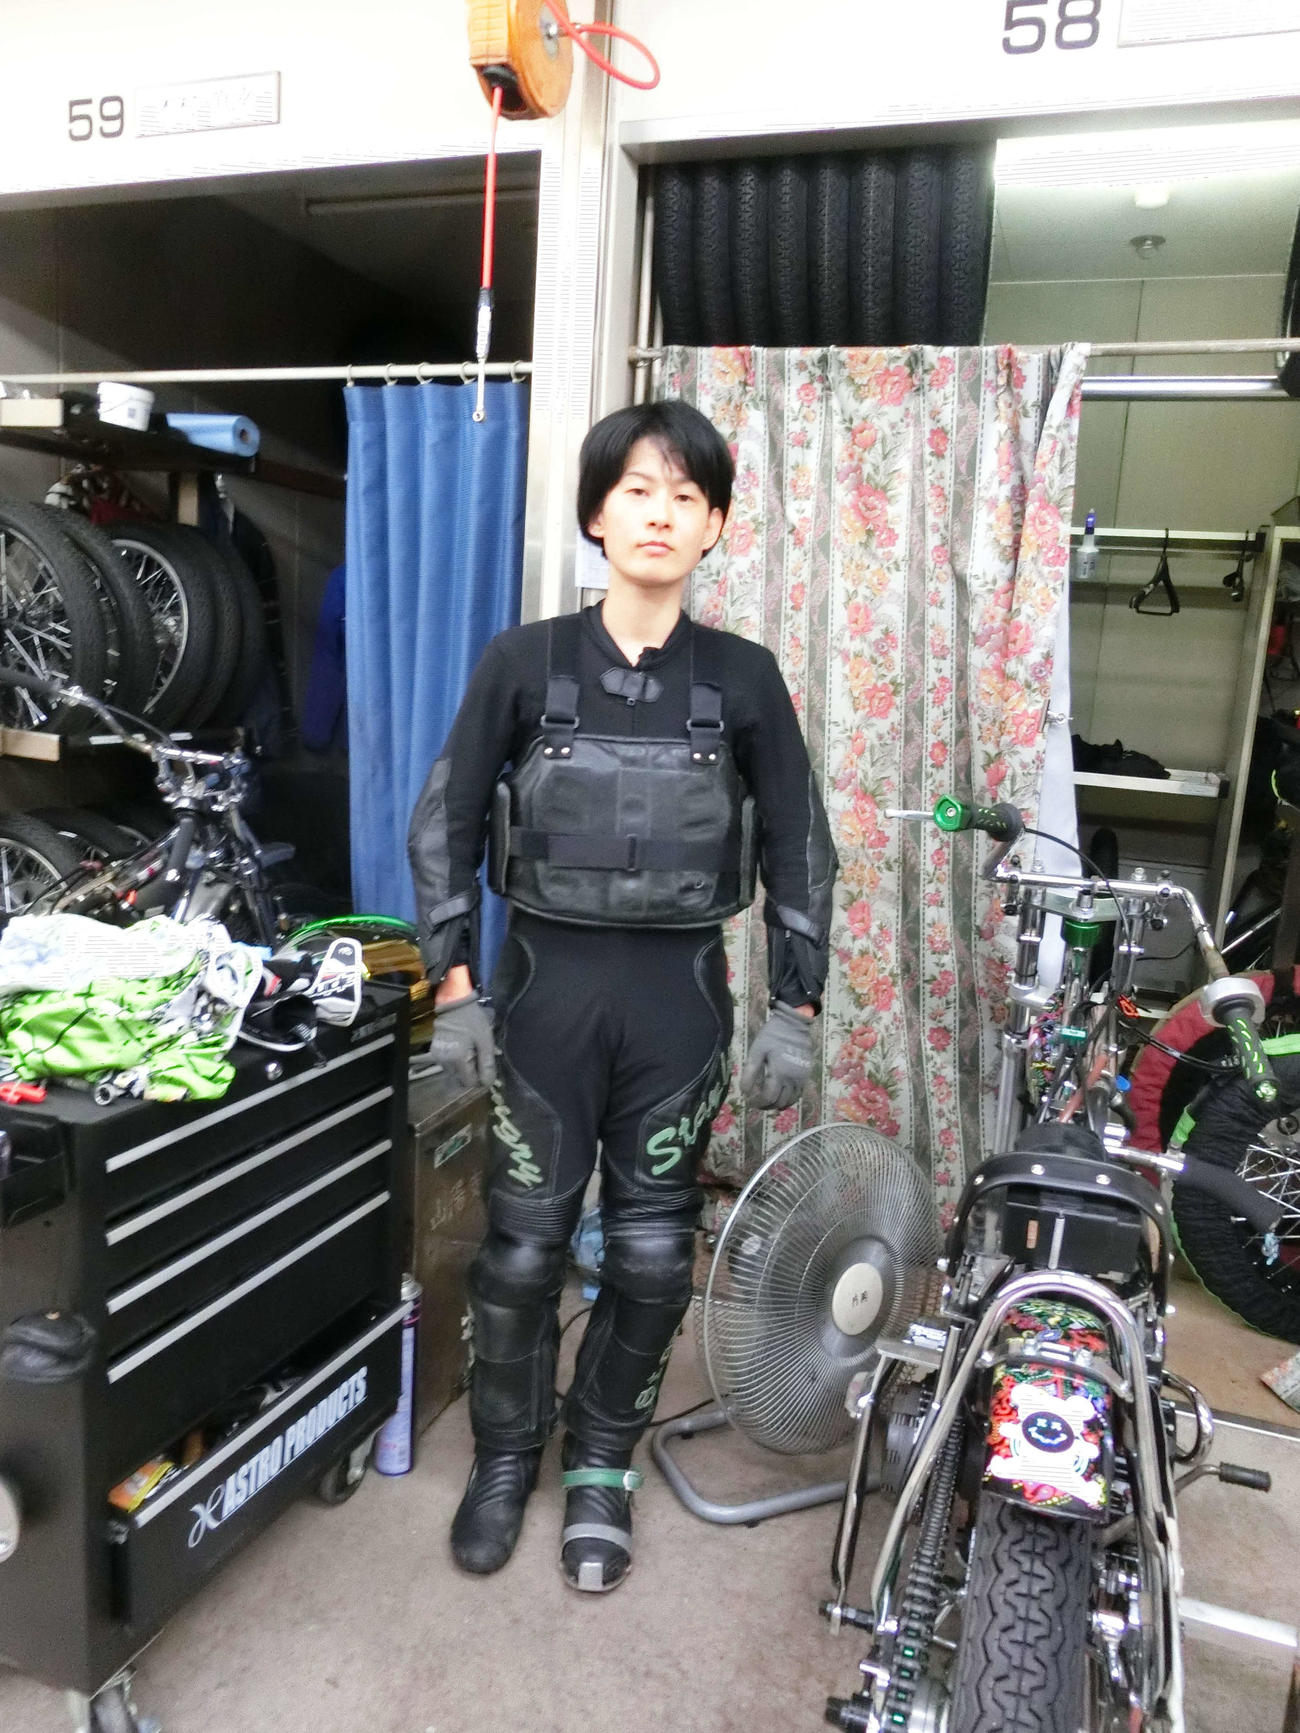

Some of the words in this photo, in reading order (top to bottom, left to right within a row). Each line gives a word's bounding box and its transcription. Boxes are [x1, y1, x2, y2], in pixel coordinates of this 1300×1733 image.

[1002, 0, 1101, 54] 58
[68, 95, 124, 141] 59
[222, 1435, 284, 1518] ASTRO
[283, 1365, 368, 1466] PRODUCTS
